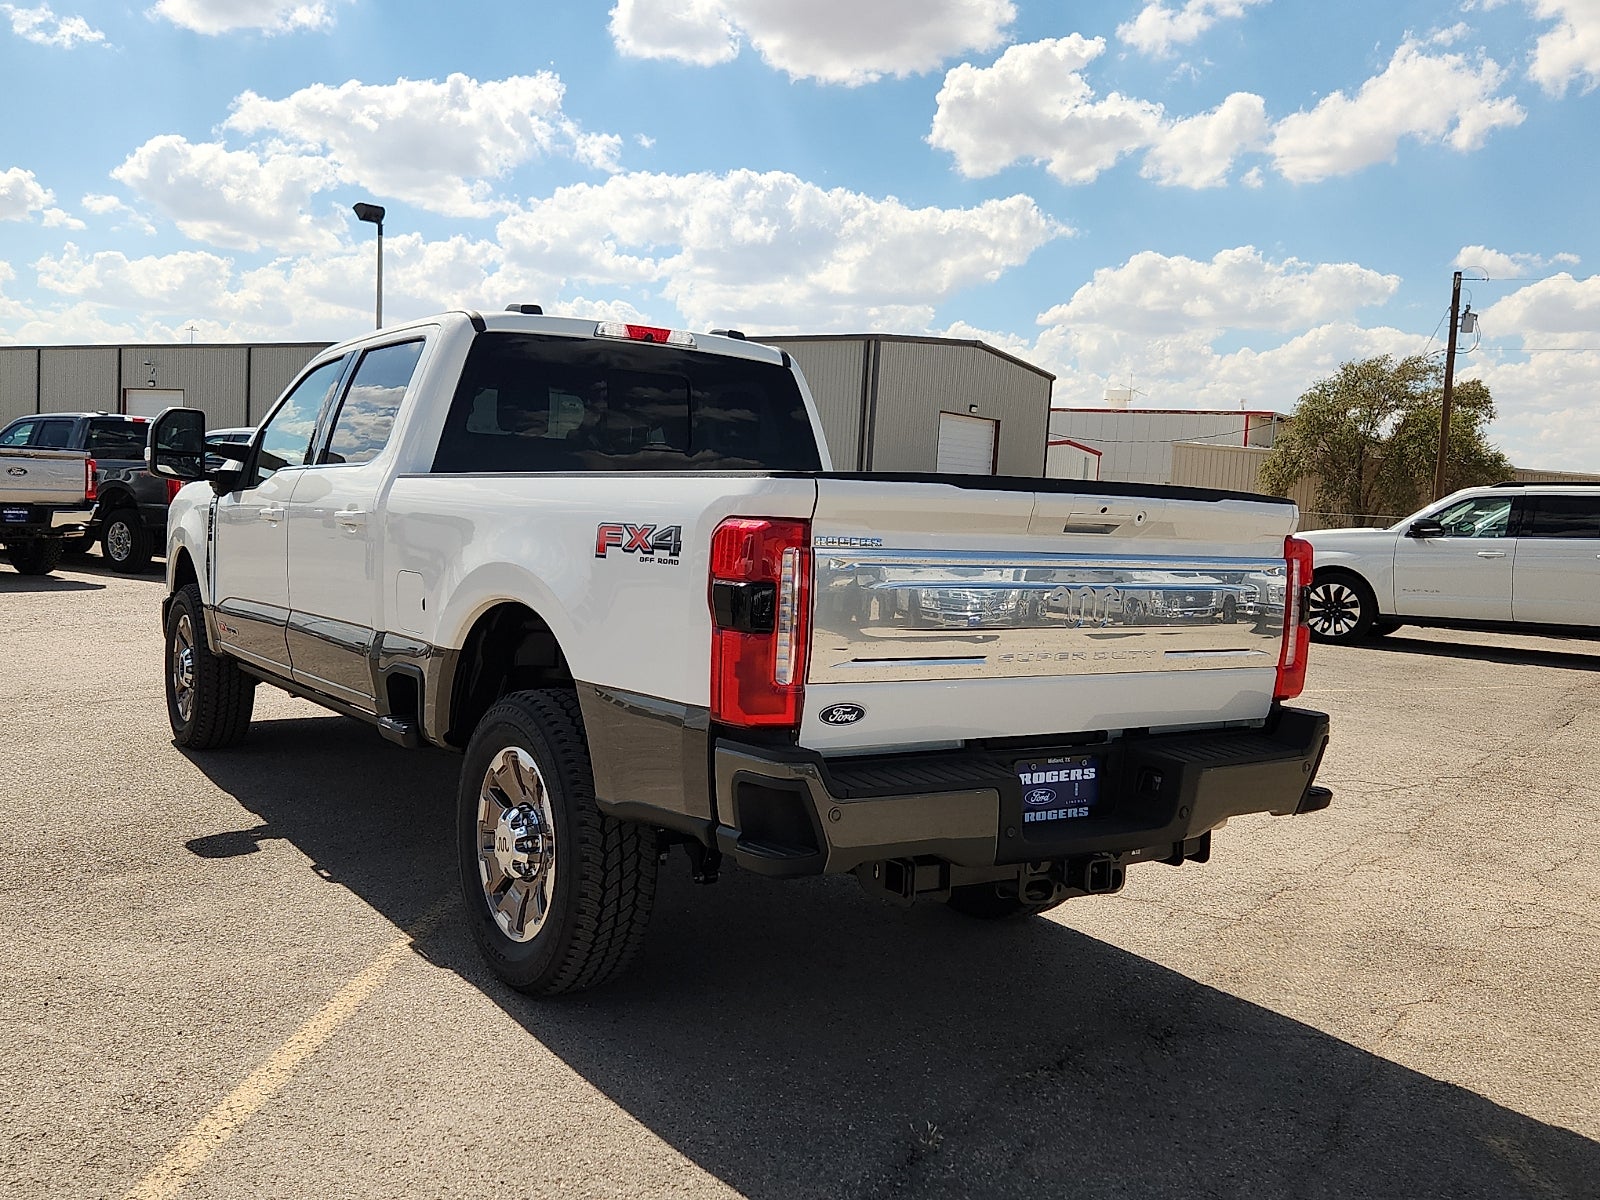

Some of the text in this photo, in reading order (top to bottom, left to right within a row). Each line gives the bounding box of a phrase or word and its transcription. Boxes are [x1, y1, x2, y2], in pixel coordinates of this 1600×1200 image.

[595, 522, 682, 558] FX4
[639, 556, 680, 566] OFF ROAD
[998, 650, 1157, 663] SUPER DUTY
[1019, 768, 1096, 785] ROGERS
[1024, 807, 1089, 822] ROGERS
